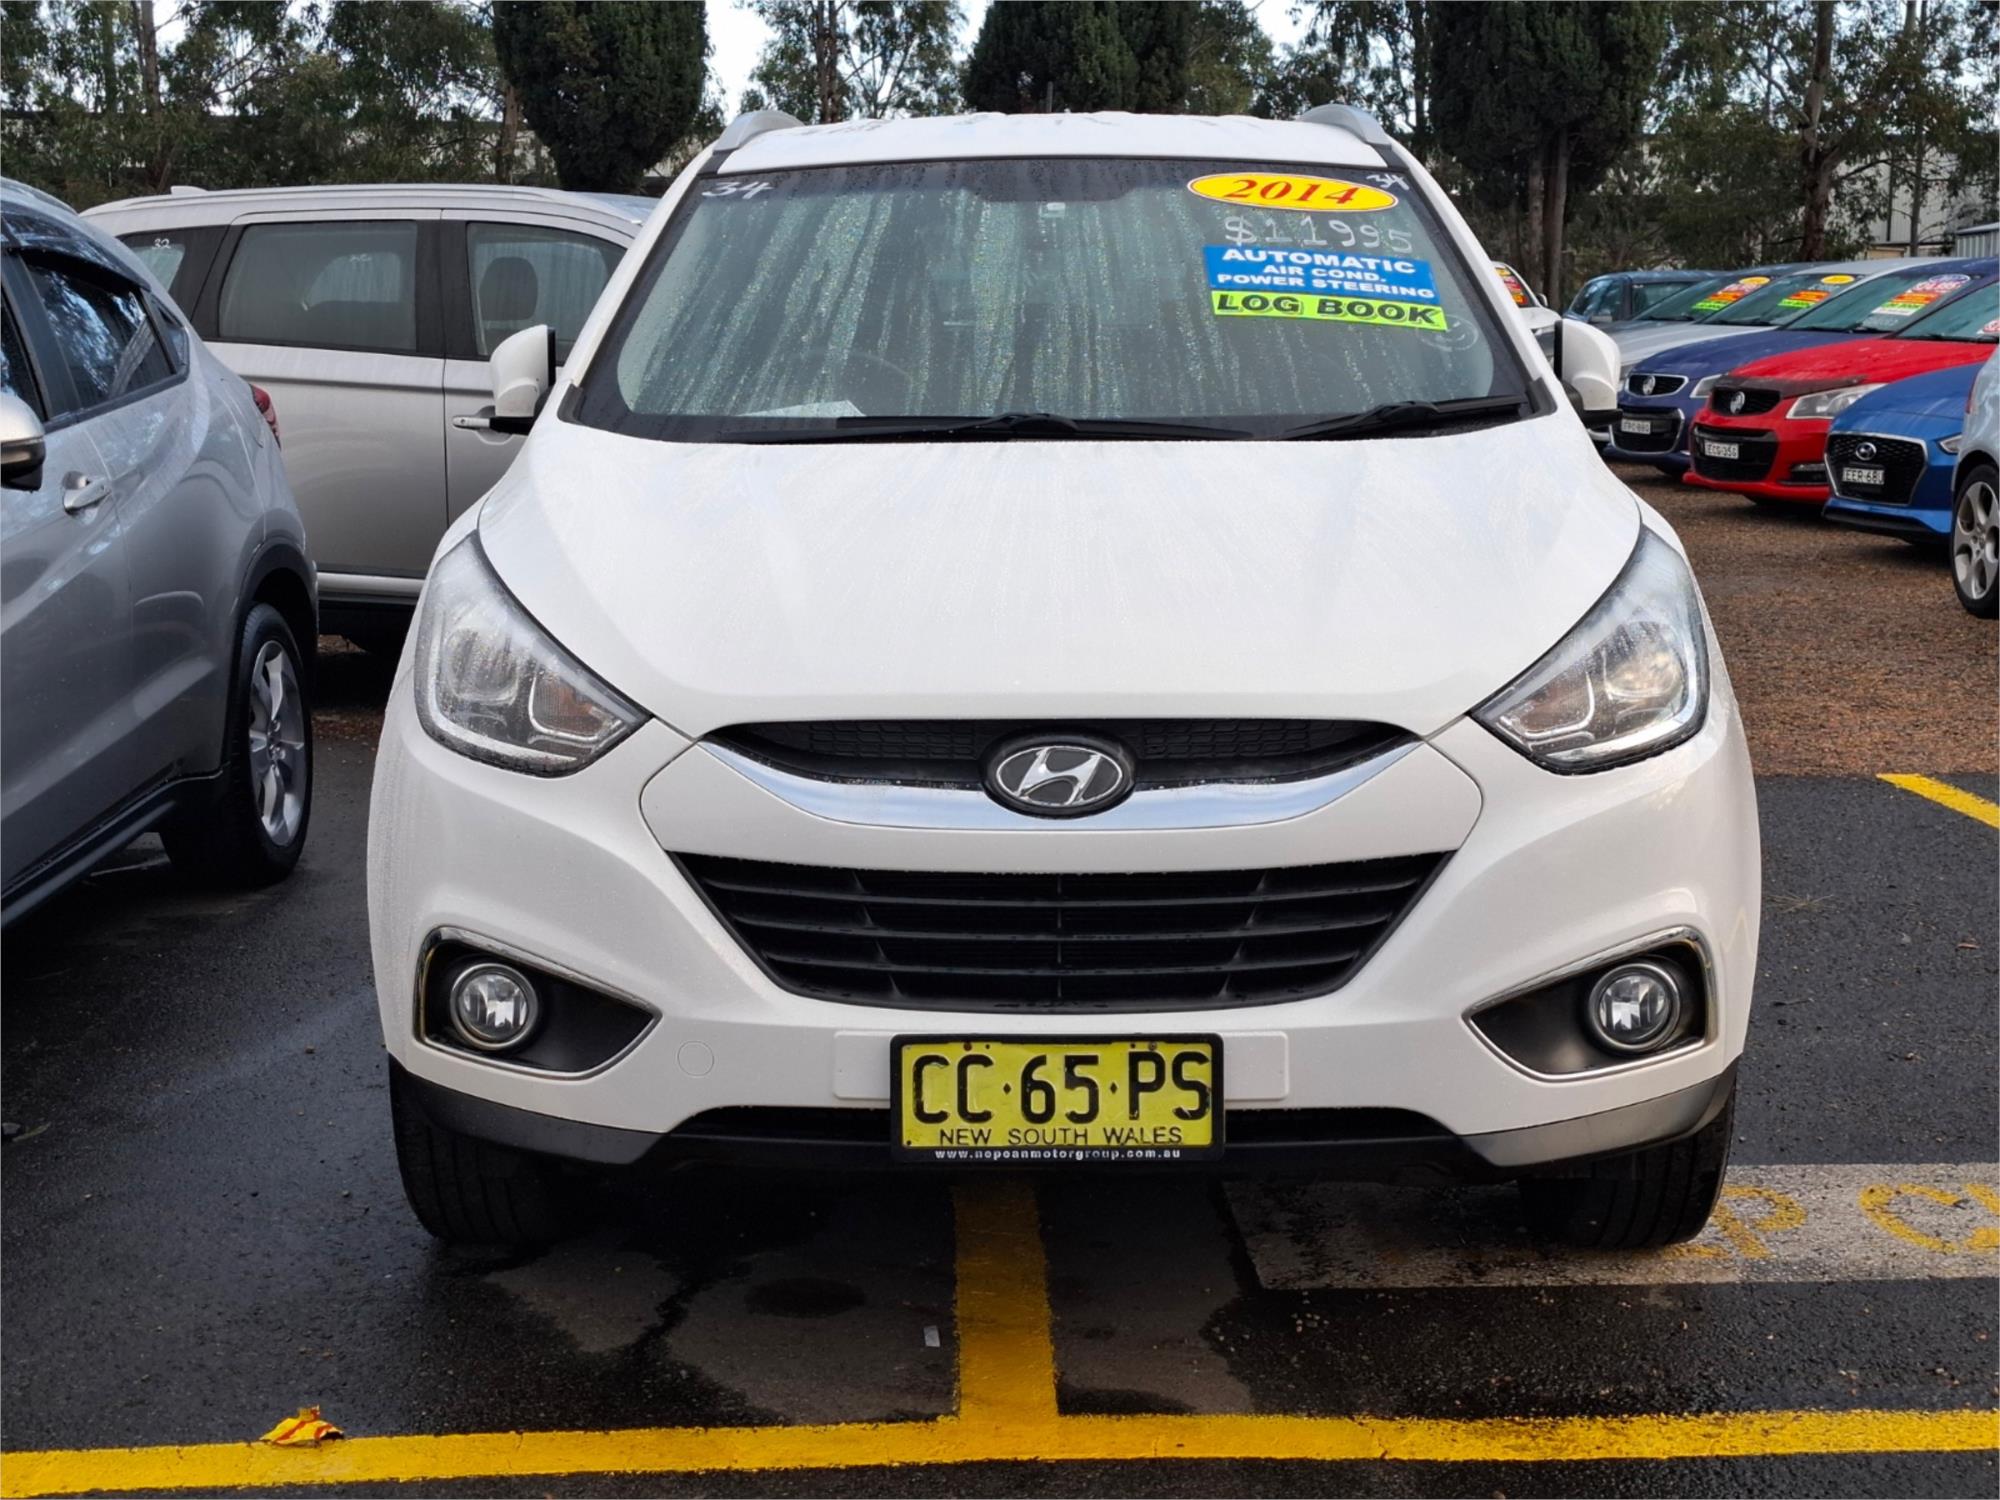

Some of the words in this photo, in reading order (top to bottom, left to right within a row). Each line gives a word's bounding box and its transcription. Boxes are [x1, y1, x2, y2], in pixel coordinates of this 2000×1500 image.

[702, 181, 774, 199] 34
[1223, 179, 1362, 204] 2014
[1224, 215, 1413, 254] $11995
[1222, 249, 1416, 273] AUTOMATIC
[1263, 264, 1304, 275] AIR
[1312, 268, 1386, 282] COND.
[1217, 274, 1304, 286] POWER
[1312, 277, 1435, 298] STEERING
[1217, 294, 1304, 313] LOG
[1317, 298, 1438, 325] BOOK
[940, 1128, 992, 1145] NEW
[1008, 1128, 1088, 1145] SOUTH
[1103, 1126, 1182, 1145] WALES
